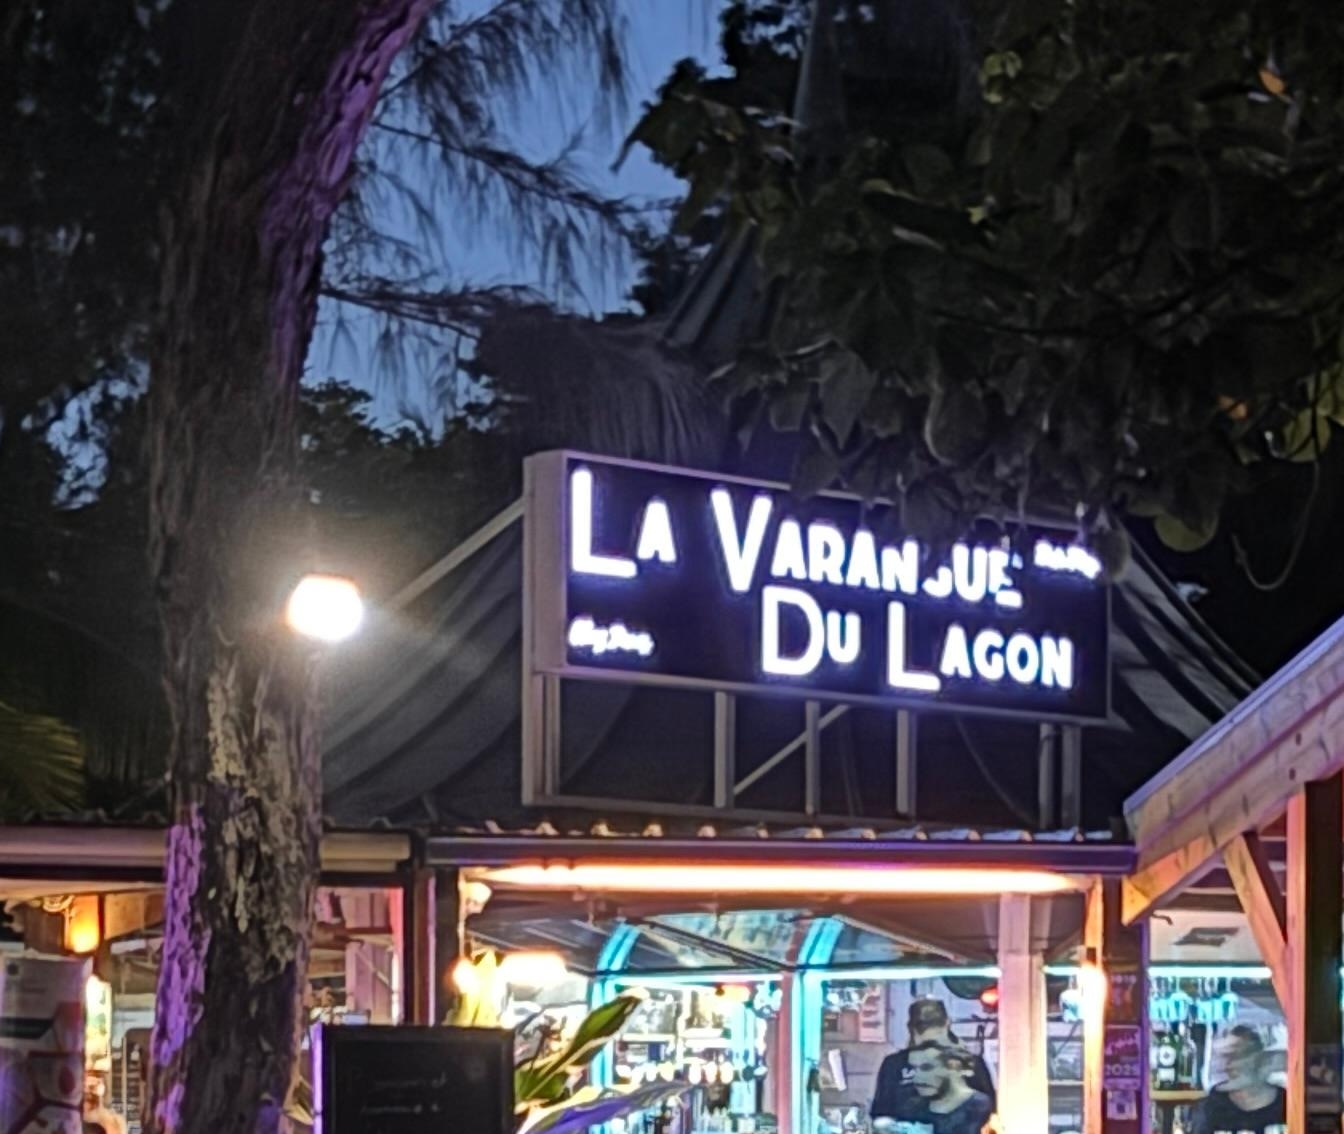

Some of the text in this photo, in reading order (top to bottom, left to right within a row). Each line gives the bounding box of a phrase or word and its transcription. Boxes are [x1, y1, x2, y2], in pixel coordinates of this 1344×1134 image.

[571, 466, 677, 578] LA
[762, 586, 861, 676] DU
[888, 602, 1073, 692] LAGON
